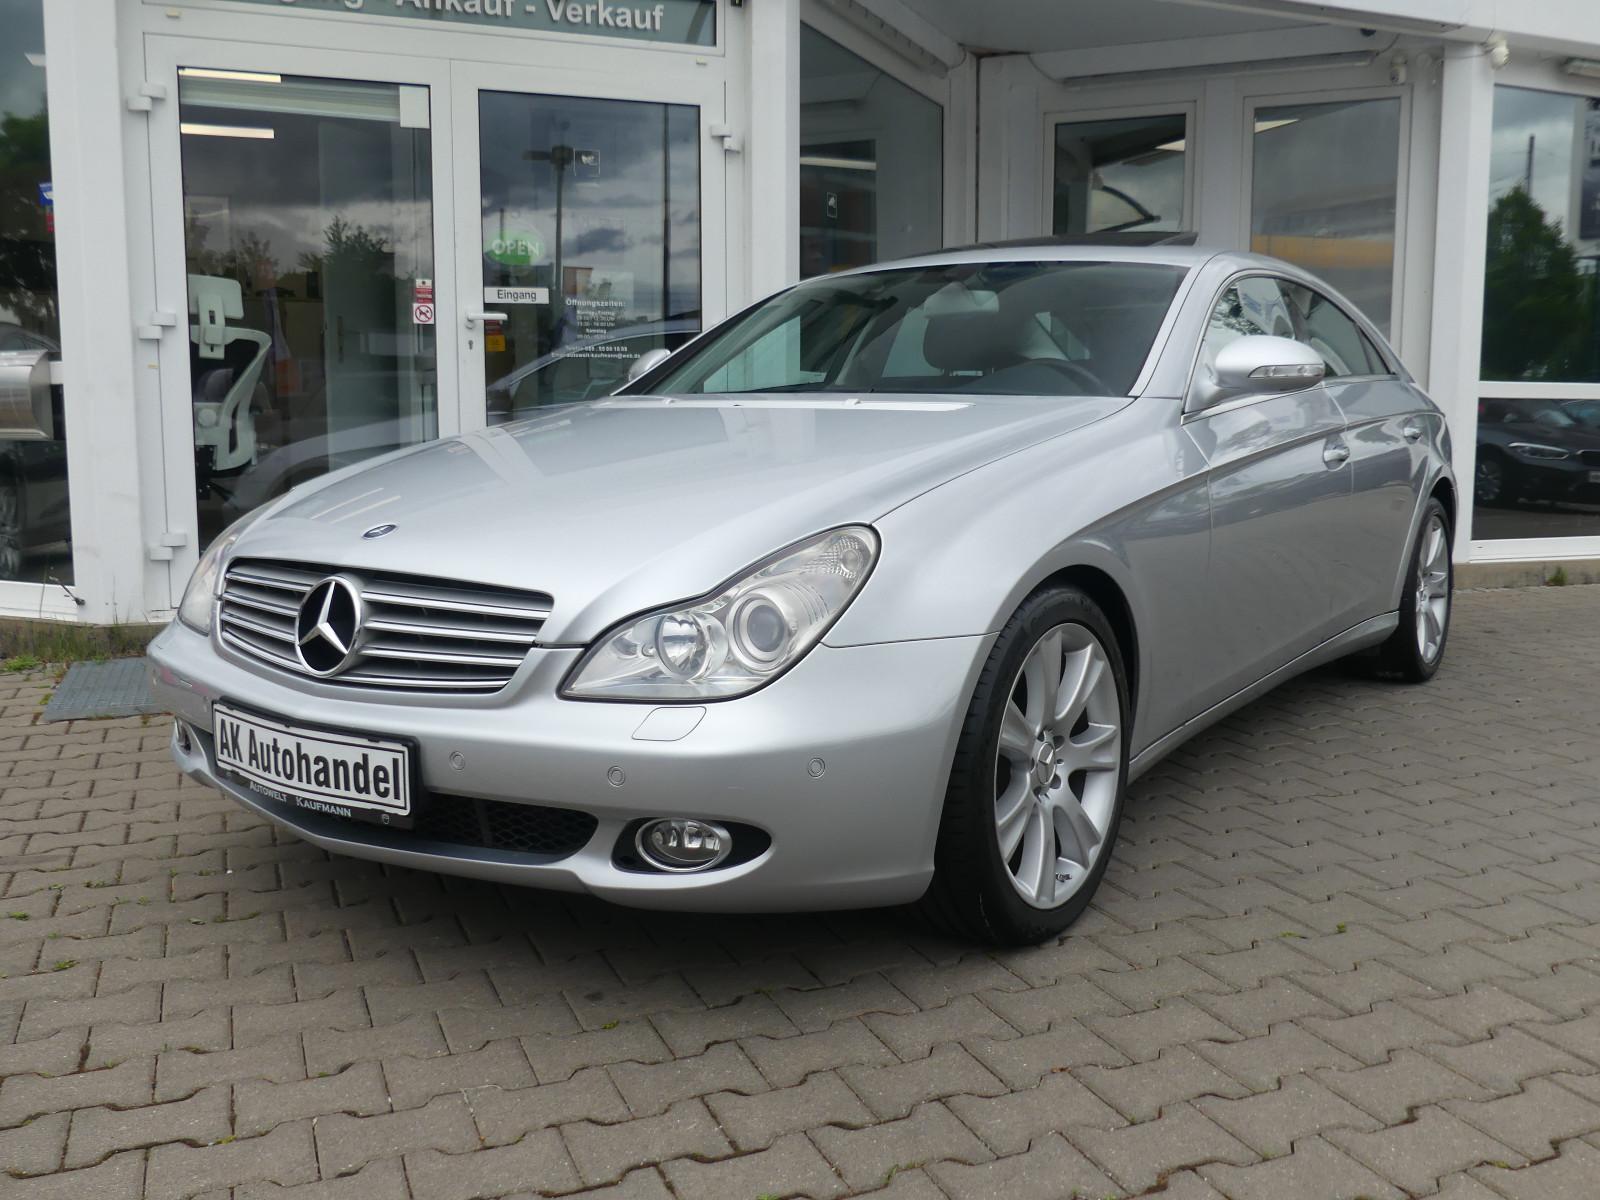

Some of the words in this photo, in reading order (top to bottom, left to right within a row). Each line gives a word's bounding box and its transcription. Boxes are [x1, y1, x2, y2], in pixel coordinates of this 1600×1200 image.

[546, 0, 665, 31] Verkauf
[491, 239, 540, 257] OPEN
[497, 289, 537, 302] Eingang
[219, 717, 244, 764] AK
[249, 728, 401, 801] Autohandel
[249, 780, 288, 802] AUTOWELT
[296, 796, 352, 818] KAUFMANN
